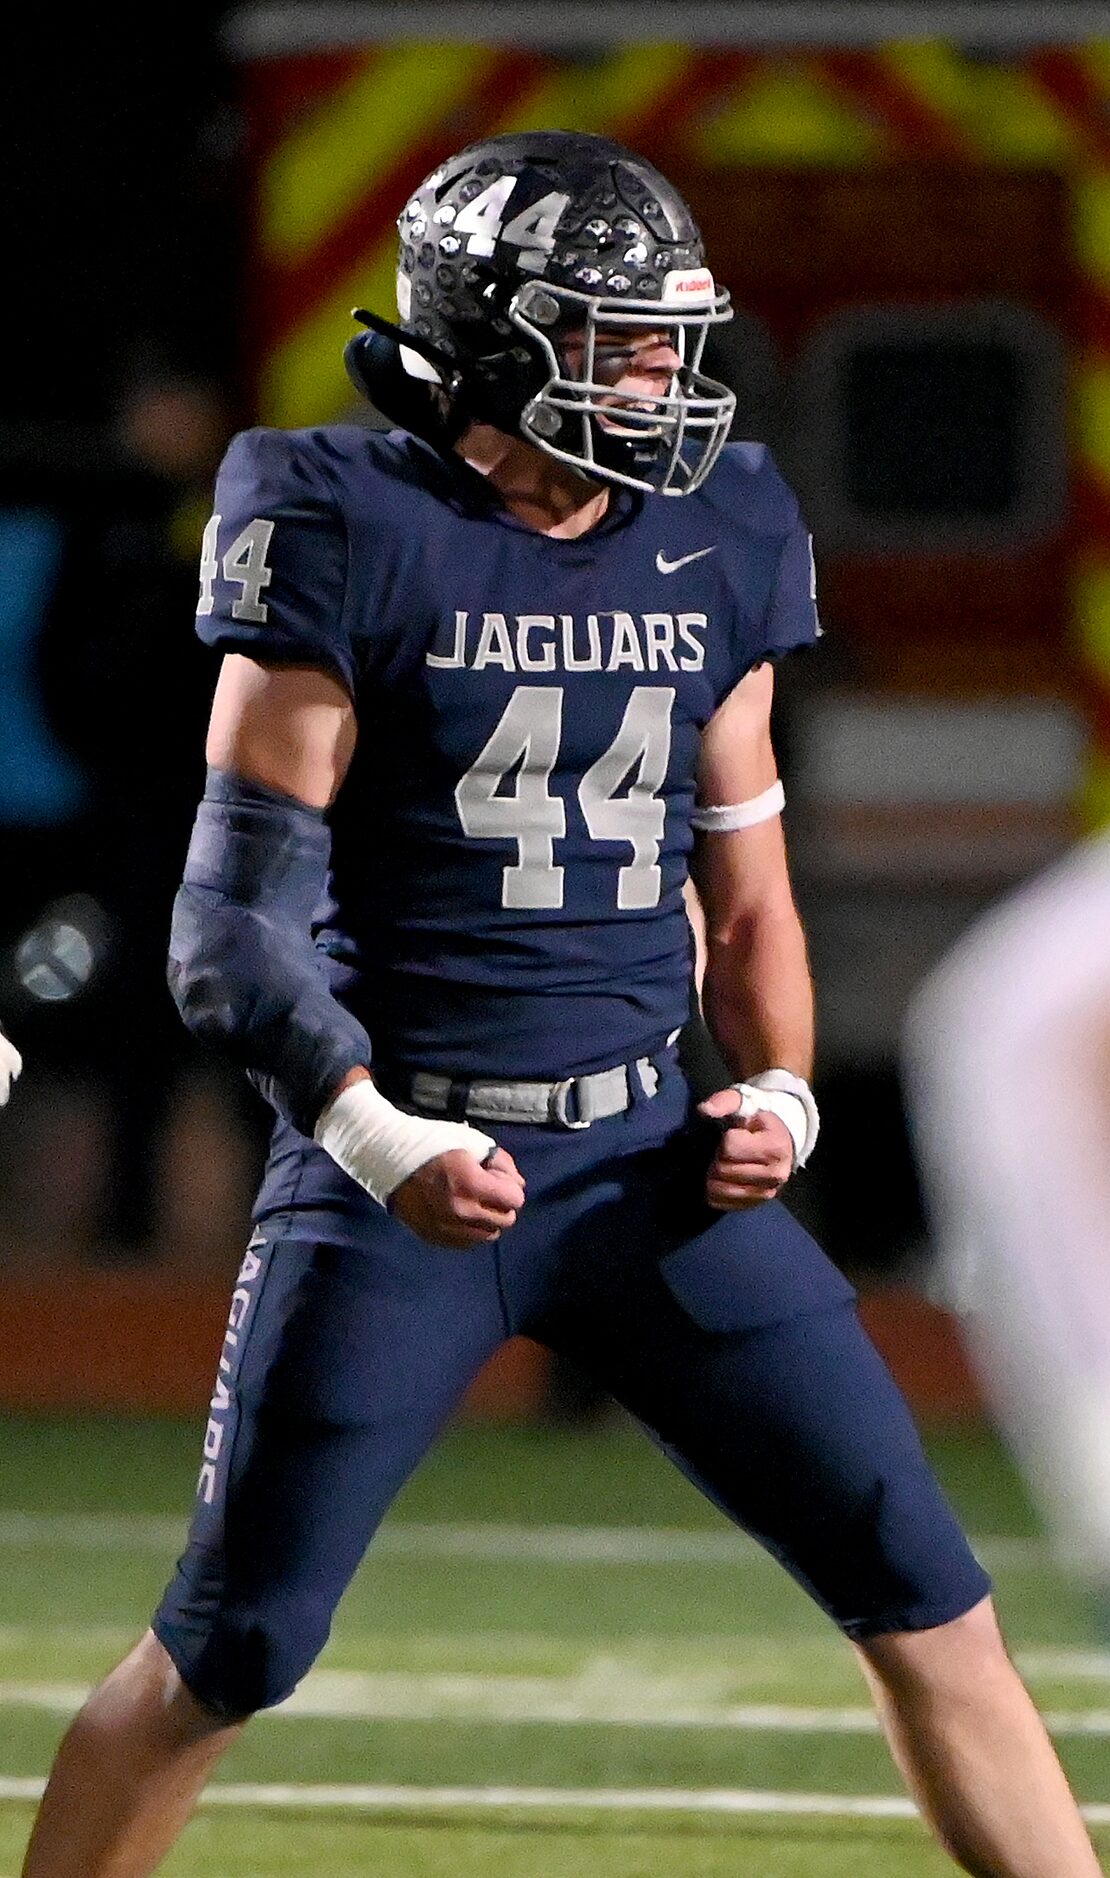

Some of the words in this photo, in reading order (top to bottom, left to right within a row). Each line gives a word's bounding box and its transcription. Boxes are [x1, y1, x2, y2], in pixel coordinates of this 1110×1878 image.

[453, 175, 571, 274] 44
[425, 610, 708, 672] JAGUARS
[454, 686, 676, 909] 44
